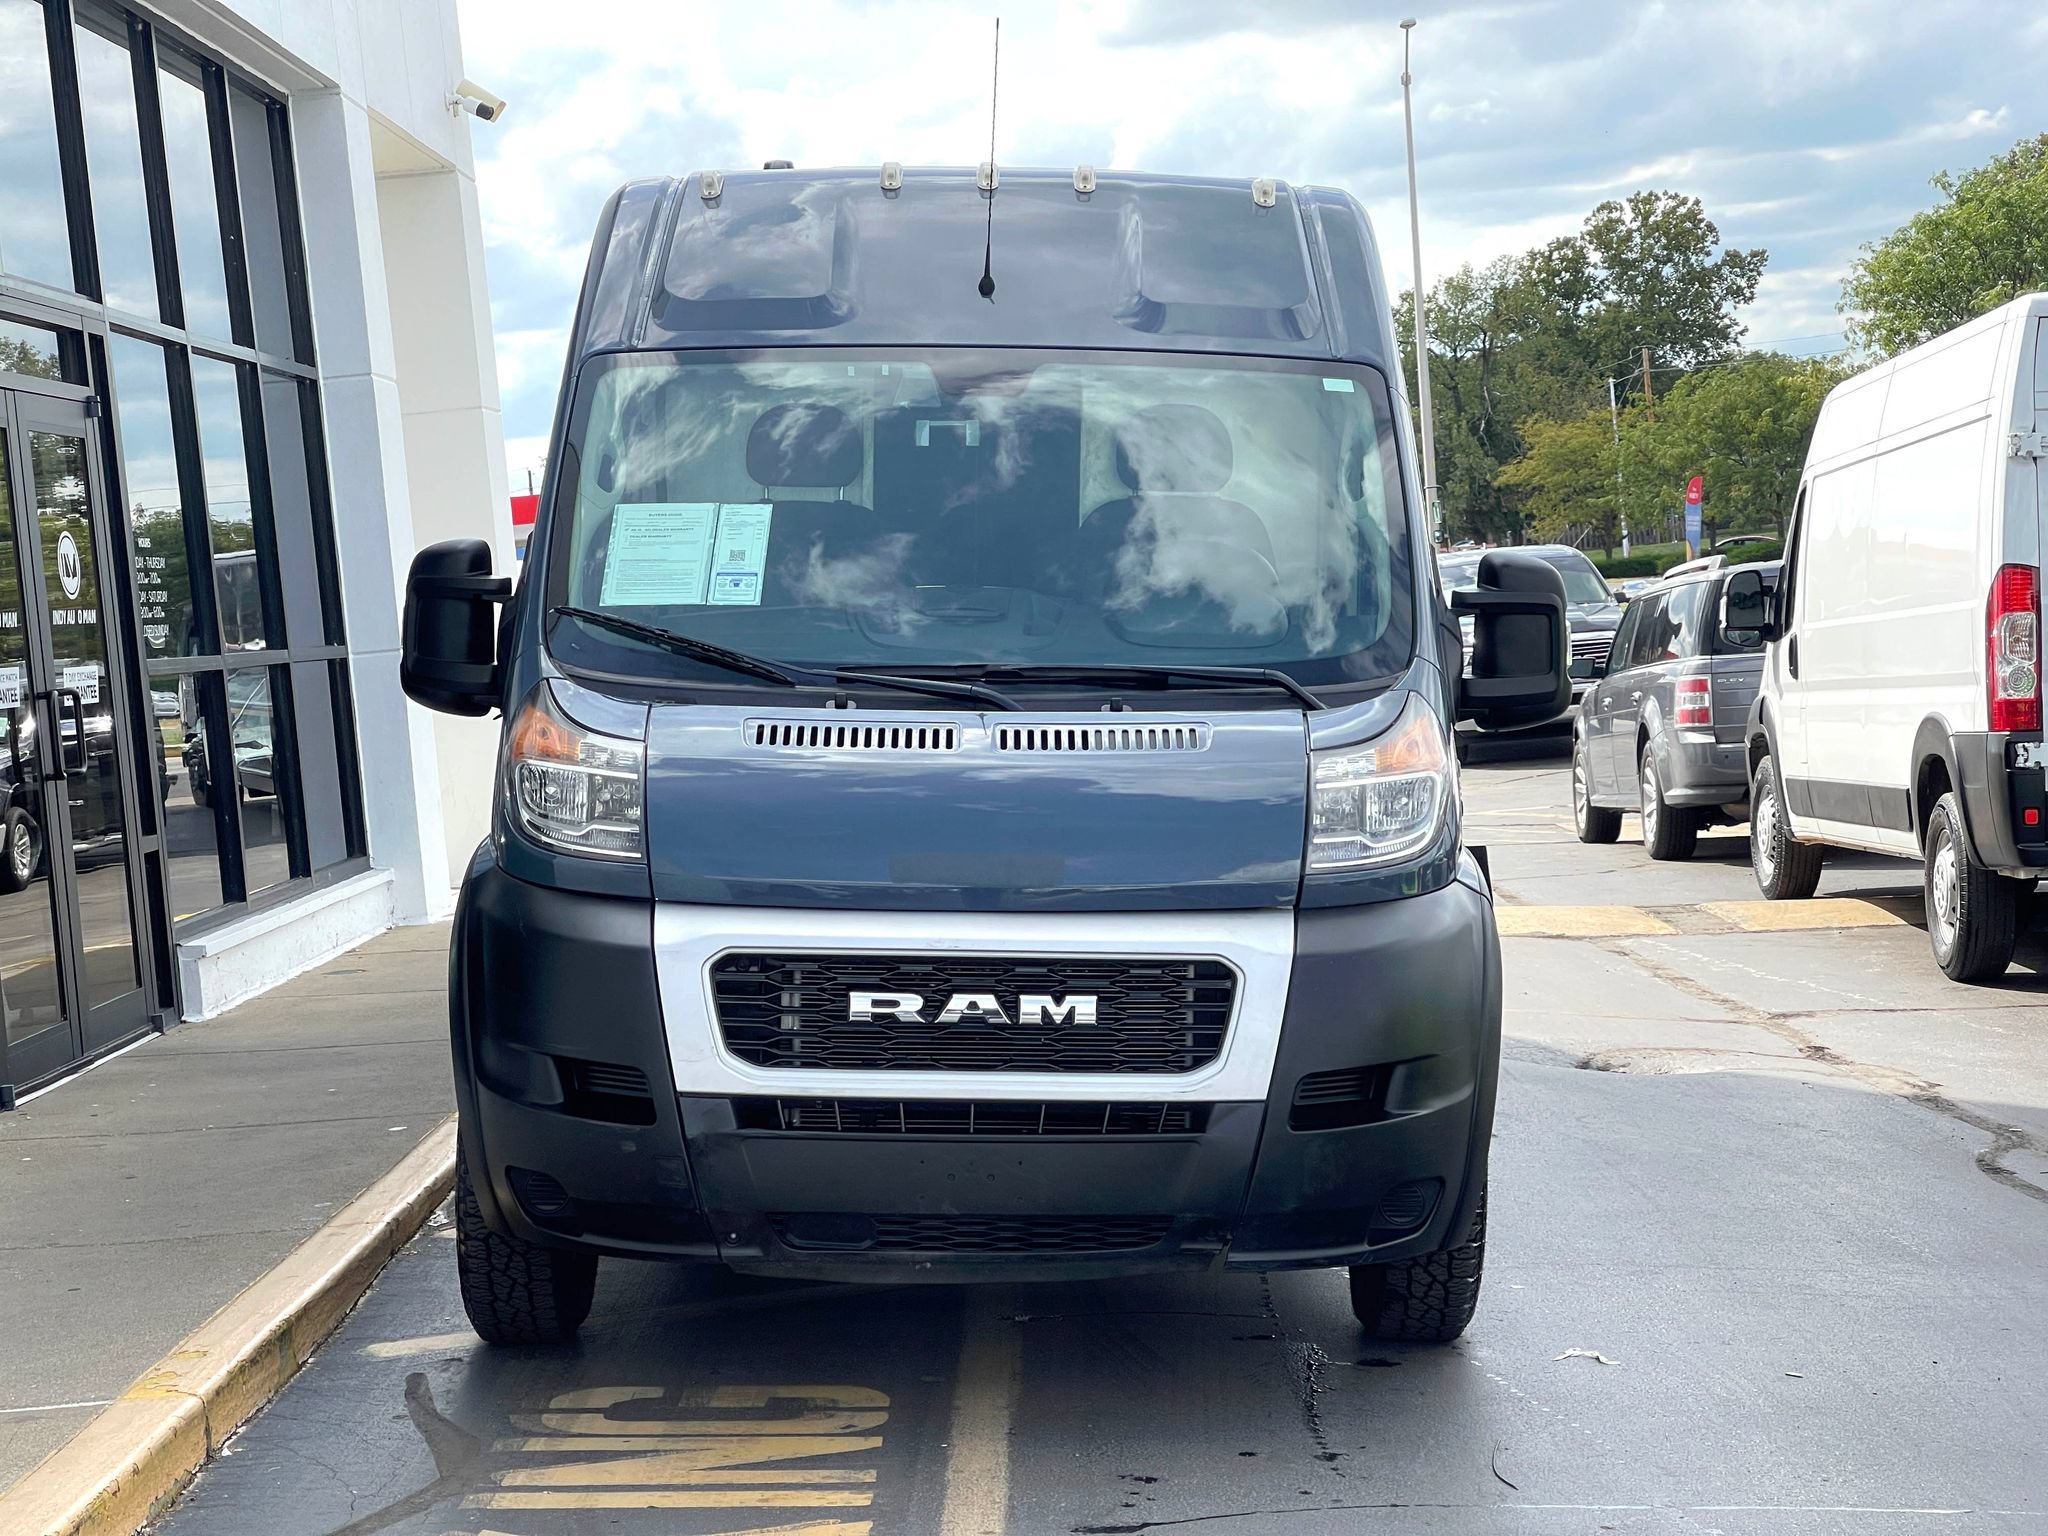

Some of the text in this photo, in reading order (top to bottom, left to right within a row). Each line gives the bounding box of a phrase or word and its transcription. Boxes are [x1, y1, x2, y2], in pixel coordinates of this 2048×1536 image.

[137, 537, 151, 548] HOURS
[2, 611, 18, 628] MAN
[82, 609, 97, 624] MAN
[849, 991, 1098, 1026] RAM
